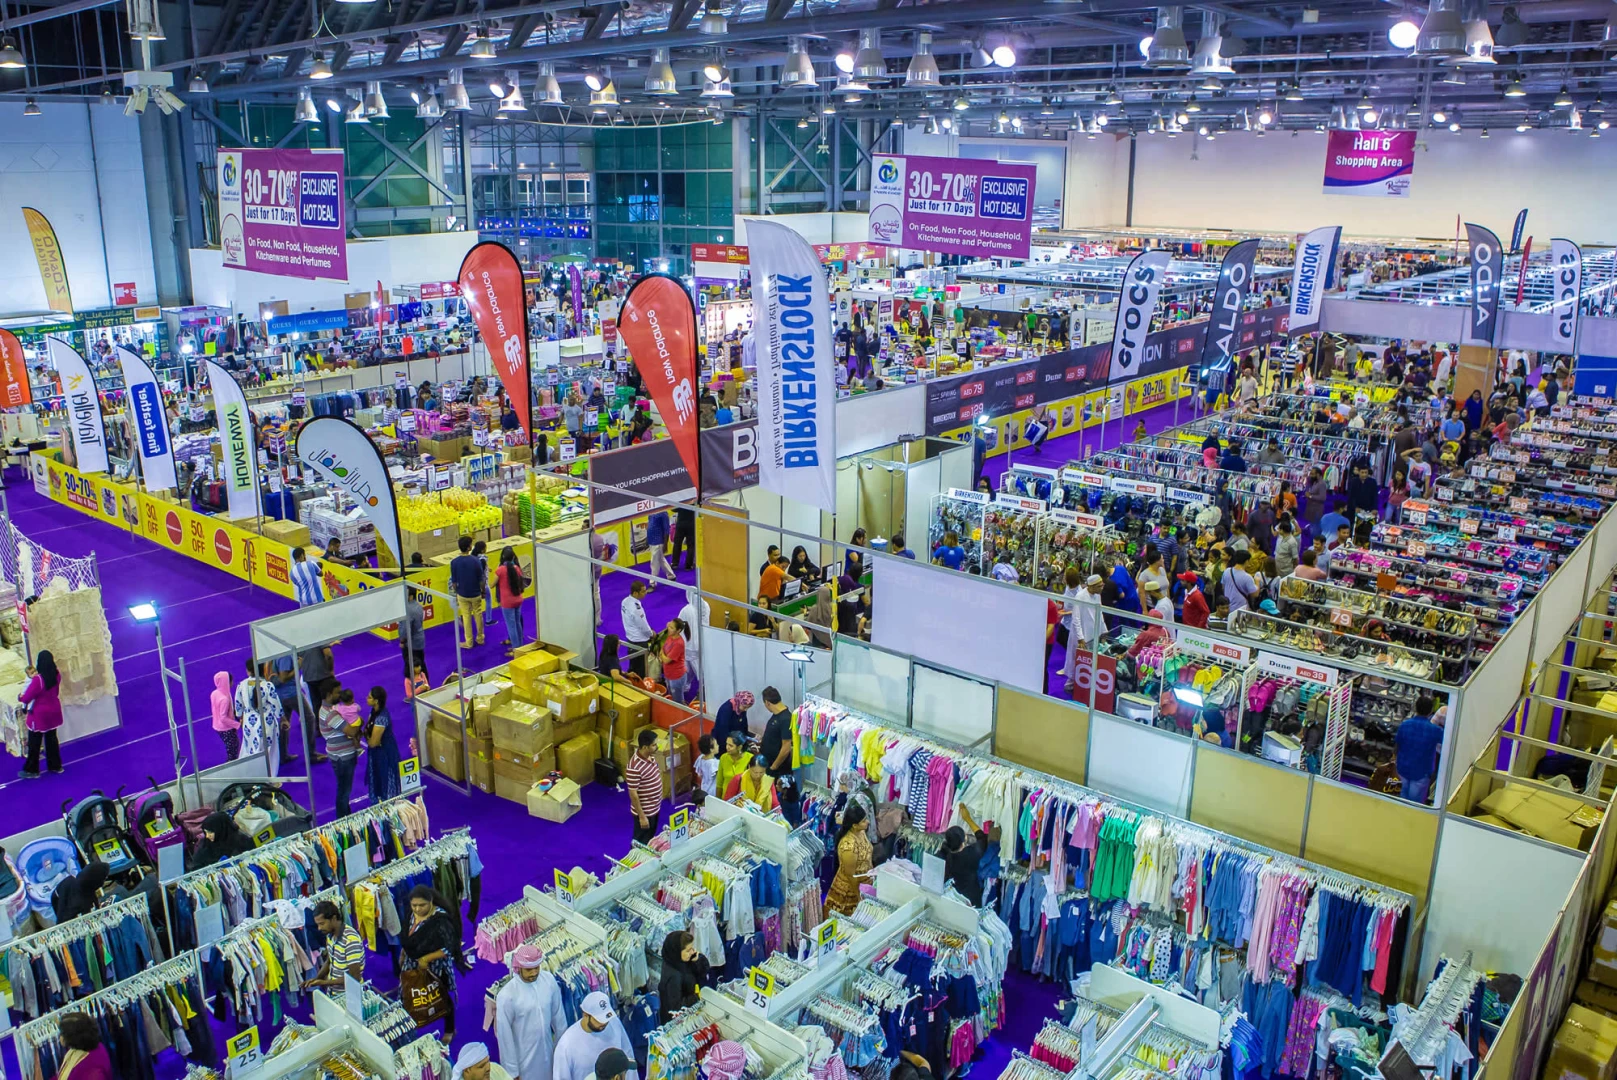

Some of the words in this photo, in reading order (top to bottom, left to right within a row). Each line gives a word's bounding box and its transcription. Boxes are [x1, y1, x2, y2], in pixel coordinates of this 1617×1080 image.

[1353, 137, 1379, 151] Hall
[1382, 137, 1391, 151] 6
[1335, 155, 1379, 168] Shopping
[1380, 156, 1403, 167] Area
[302, 178, 337, 196] EXCLUSIVE
[964, 174, 978, 188] OFF
[983, 181, 1026, 197] EXCLUSIVE
[246, 207, 259, 220] Just
[260, 208, 270, 217] for
[271, 208, 279, 218] 17
[281, 209, 296, 224] Days
[303, 204, 318, 221] HOT
[318, 205, 336, 222] DEAL
[909, 200, 928, 210] Just
[928, 200, 940, 211] for
[942, 201, 952, 212] 17
[954, 203, 974, 216] Days
[983, 201, 1001, 214] HOT
[1001, 203, 1022, 216] DEAL
[909, 223, 919, 232] On
[920, 224, 940, 234] Food,
[942, 226, 956, 235] Non
[957, 227, 978, 238] Food,
[979, 229, 1023, 242] HouseHold,
[248, 237, 257, 247] On
[256, 238, 272, 250] Food,
[273, 240, 285, 250] Non
[303, 243, 340, 257] HouseHold,
[918, 233, 960, 245] Kitchenware
[962, 238, 976, 247] and
[977, 239, 1012, 250] Perfumes
[255, 250, 290, 263] Kitchenware
[290, 255, 301, 265] and
[302, 255, 332, 268] Perfumes
[1295, 243, 1321, 315] BIRKENSTOCK
[1216, 262, 1247, 357] ALDO
[86, 320, 97, 328] BUY
[103, 319, 114, 327] GET
[120, 317, 134, 325] FREE
[300, 318, 319, 326] GUESS
[1118, 266, 1155, 369] crocs
[1025, 372, 1033, 381] 79
[1045, 373, 1062, 382] Dune
[963, 388, 972, 396] AED
[973, 383, 983, 395] 79
[1024, 395, 1034, 404] 49
[933, 412, 957, 424] BIRKENSTOCK
[961, 410, 971, 418] AED
[971, 403, 984, 417] 129
[64, 471, 91, 498] 30-70
[615, 481, 628, 489] YOU
[629, 478, 641, 487] FOR
[641, 470, 670, 482] SHOPPING
[670, 467, 685, 476] WITH
[954, 489, 984, 501] BIRKENSTOCK
[1173, 489, 1204, 501] BIRKENSTOCK
[637, 500, 656, 512] EXIT
[1510, 499, 1527, 510] 129
[147, 521, 159, 536] OFF
[1461, 521, 1477, 532] 129
[192, 539, 206, 555] OFF
[1408, 545, 1425, 555] 69
[1331, 611, 1350, 625] 79
[1184, 636, 1210, 650] crocs
[1215, 648, 1227, 656] AED
[1227, 649, 1238, 658] 69
[1076, 655, 1093, 665] AED
[1268, 660, 1292, 670] Dune
[1312, 671, 1324, 680] 39
[1074, 663, 1114, 695] 69
[406, 773, 417, 784] 20
[675, 826, 686, 840] 20
[107, 849, 121, 858] 449
[561, 888, 572, 903] 30
[823, 940, 835, 955] 20
[752, 991, 767, 1009] 25
[239, 1048, 257, 1067] 25
